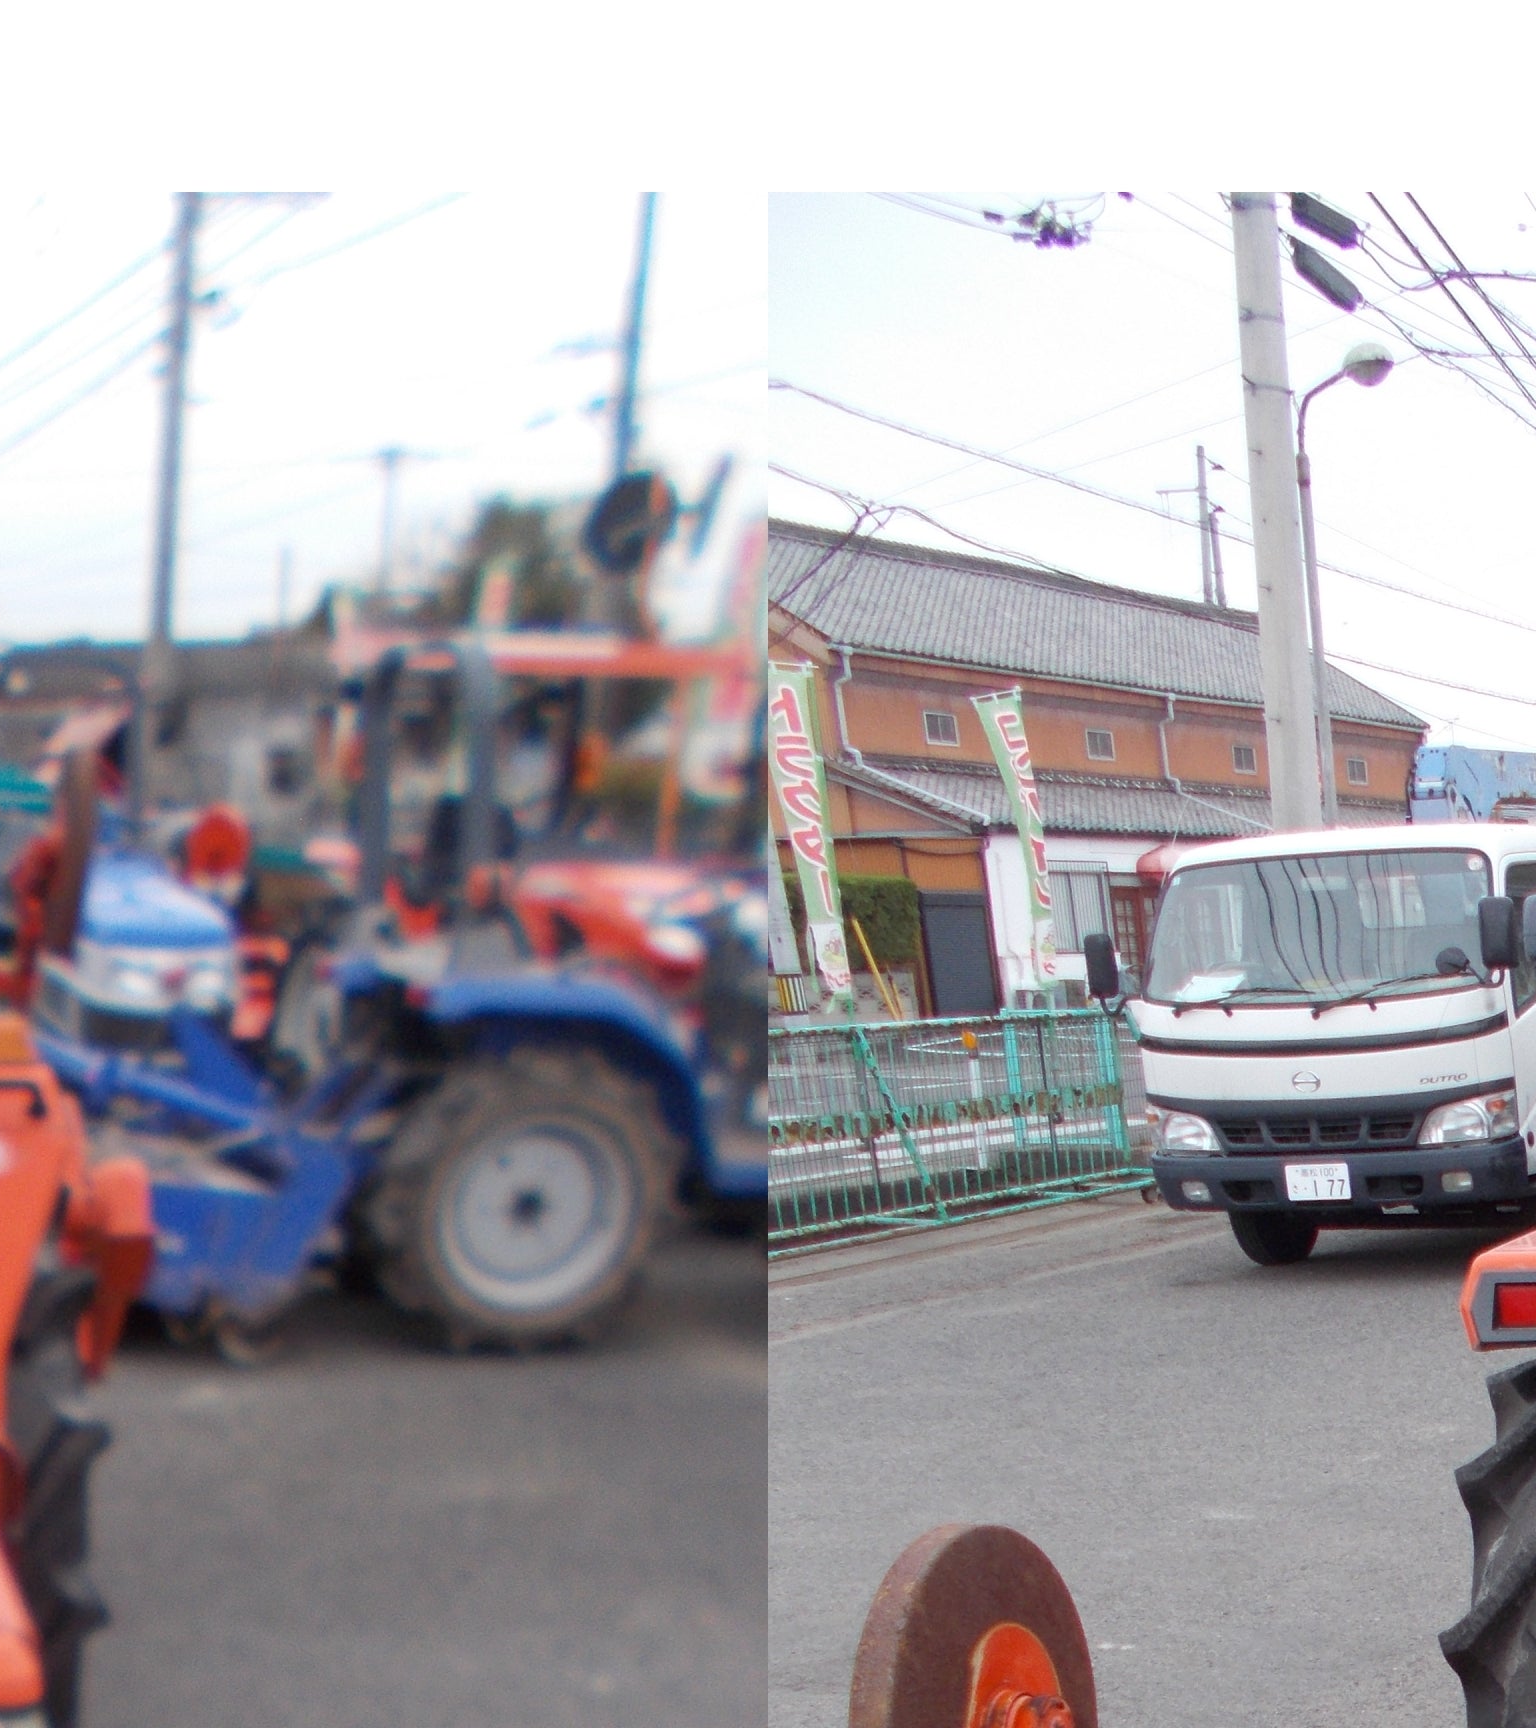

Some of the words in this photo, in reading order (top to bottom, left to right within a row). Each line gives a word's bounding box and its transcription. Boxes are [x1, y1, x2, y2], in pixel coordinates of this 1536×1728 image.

[771, 686, 835, 918] トラクター
[1419, 1073, 1468, 1085] DUTRO
